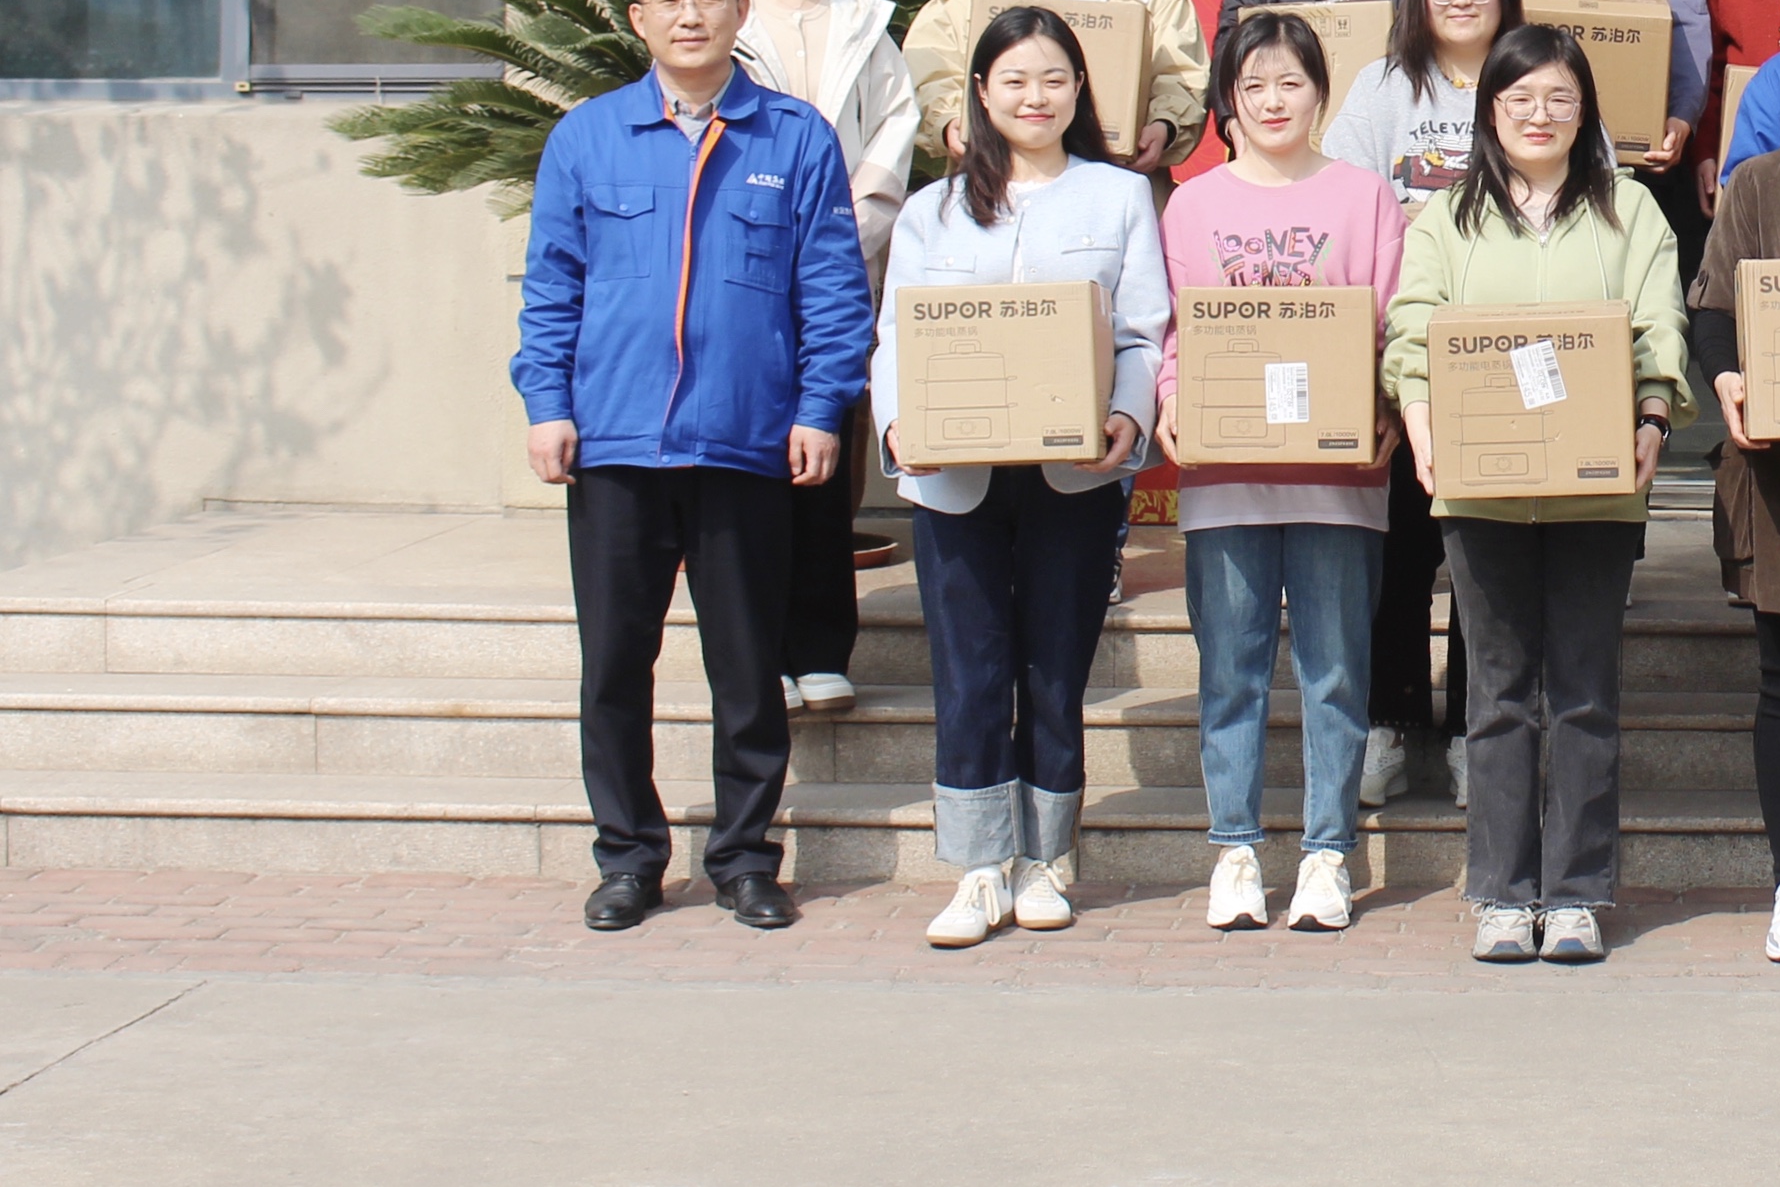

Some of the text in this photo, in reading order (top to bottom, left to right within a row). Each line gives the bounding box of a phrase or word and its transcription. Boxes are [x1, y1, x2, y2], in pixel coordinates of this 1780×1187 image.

[1064, 12, 1114, 30] 苏泊尔
[1590, 26, 1641, 44] 苏泊尔
[1213, 226, 1329, 269] LOONEY
[913, 299, 1058, 321] SUPOR 苏泊尔
[1192, 302, 1337, 319] SUPOR 苏泊尔
